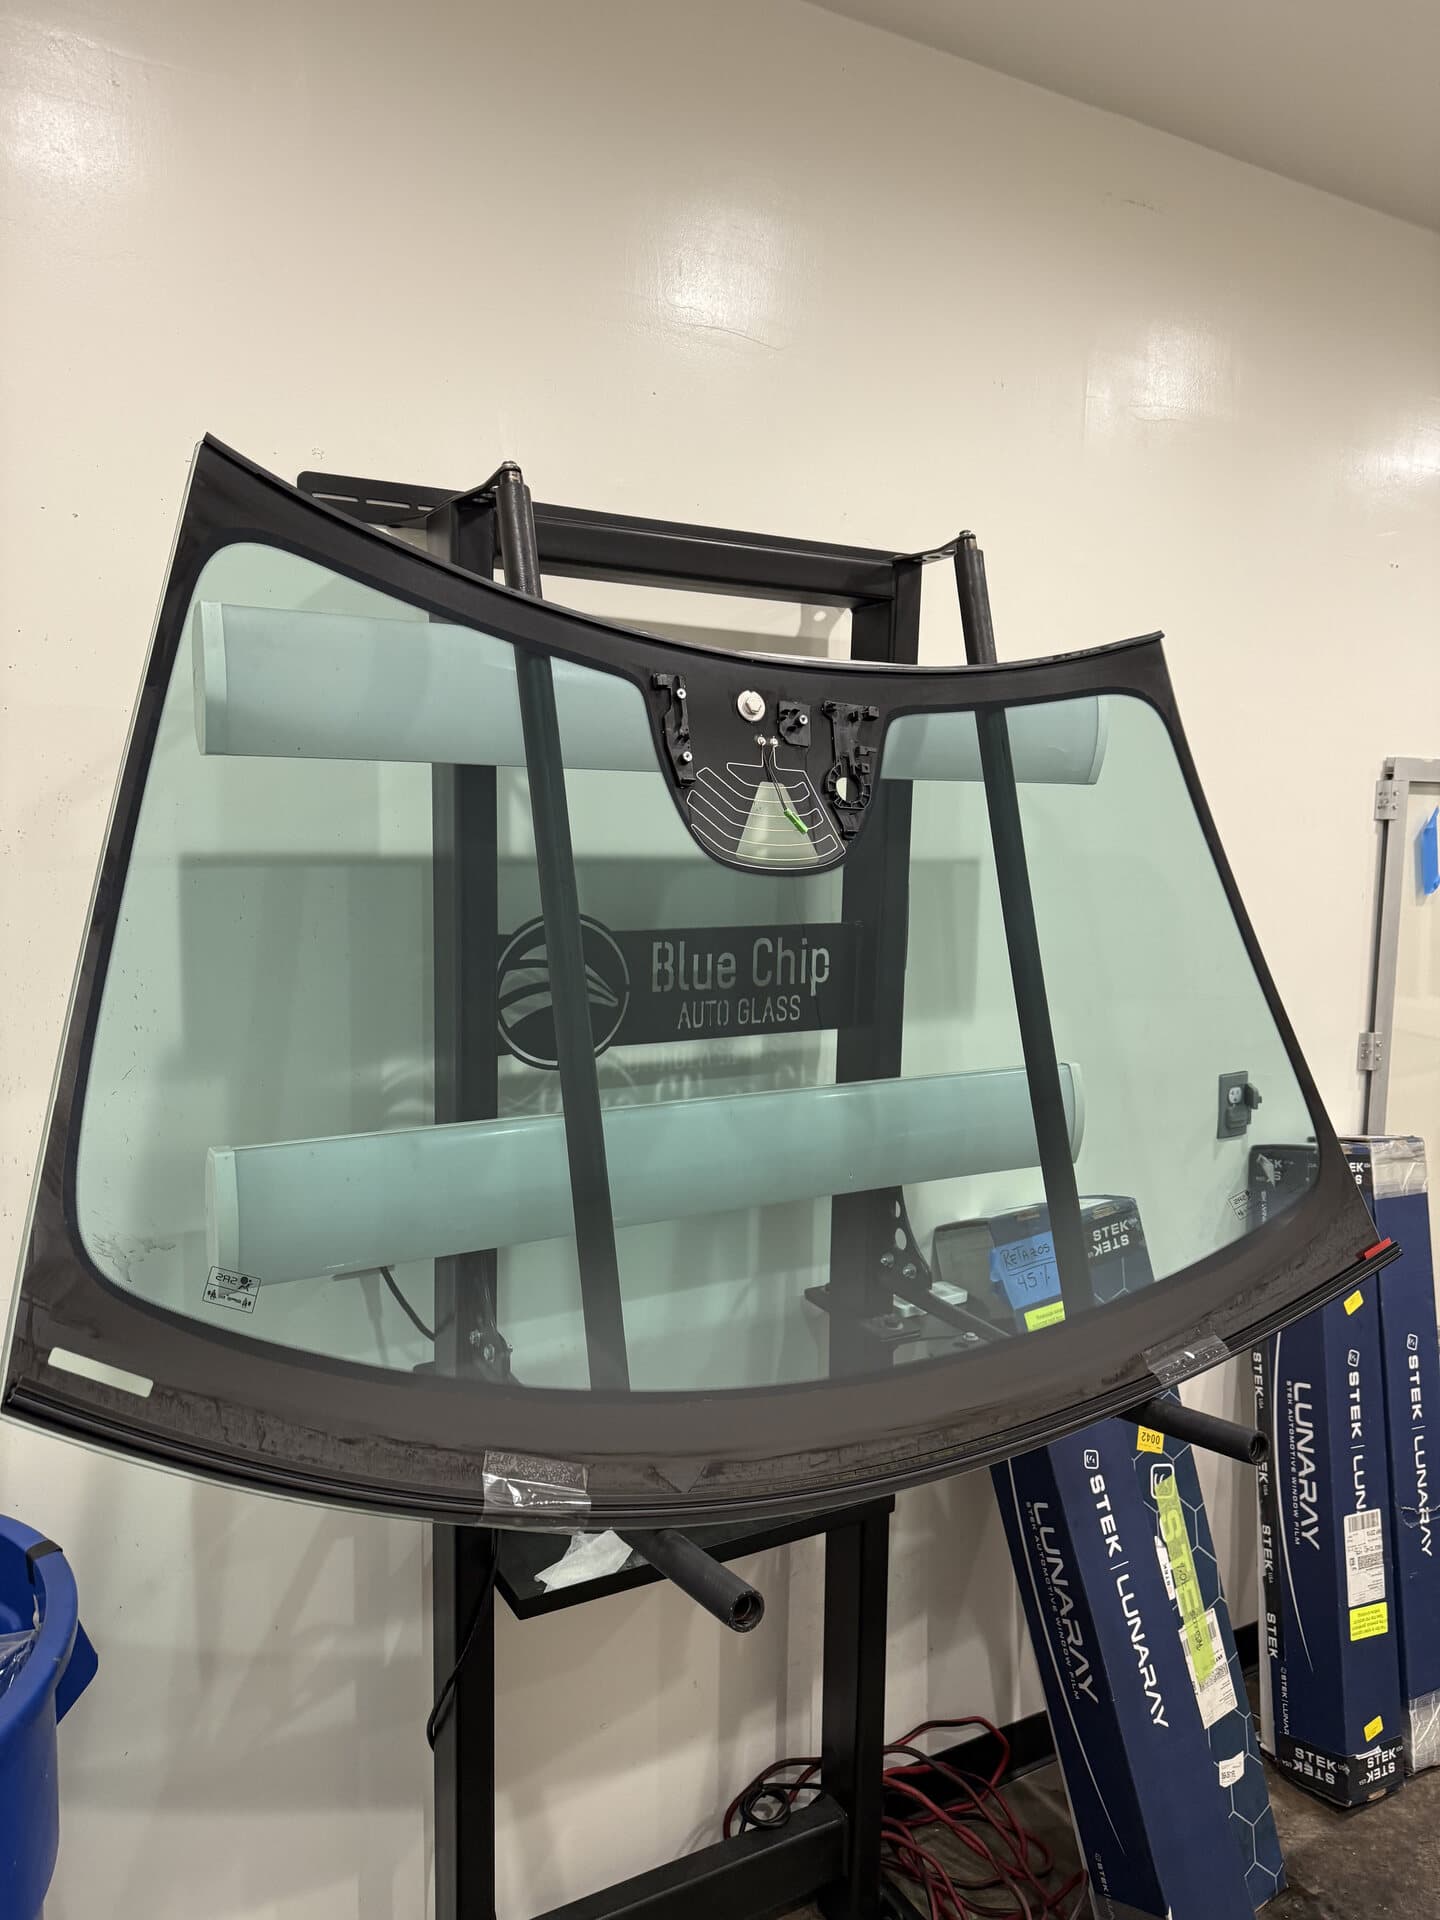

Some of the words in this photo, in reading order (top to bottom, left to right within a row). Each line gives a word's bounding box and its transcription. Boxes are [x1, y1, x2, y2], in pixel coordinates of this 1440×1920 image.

[651, 940, 737, 993] Blue
[752, 937, 831, 996] Chip
[677, 999, 730, 1030] AUTO
[737, 995, 801, 1025] GLASS
[1349, 1162, 1364, 1172] EK
[1093, 1220, 1129, 1241] STEK
[1093, 1234, 1130, 1256] STEK
[1253, 1351, 1264, 1398] STEK
[1408, 1354, 1423, 1420] STEK
[1349, 1371, 1362, 1439] STEK
[1288, 1408, 1297, 1472] AUTOMOTIVE
[1258, 1461, 1269, 1485] EK
[1293, 1382, 1320, 1550] LUNARAY
[1291, 1476, 1300, 1518] WINDOW
[1414, 1435, 1433, 1557] LUNARAY
[1262, 1524, 1274, 1572] STEK
[1033, 1502, 1099, 1704] LUNARAY
[1034, 1535, 1057, 1612] AUTOMOTIVE
[1055, 1617, 1072, 1667] WINDOW
[1069, 1671, 1081, 1700] FILM
[1089, 1474, 1122, 1558] STEK
[1115, 1574, 1169, 1728] LUNARAY
[1267, 1612, 1279, 1658] STEK
[1282, 1703, 1290, 1735] LUNAR
[1293, 1759, 1335, 1785] STEK
[1295, 1747, 1338, 1773] STEK
[1366, 1762, 1395, 1784] STEK
[1367, 1746, 1397, 1769] STEK
